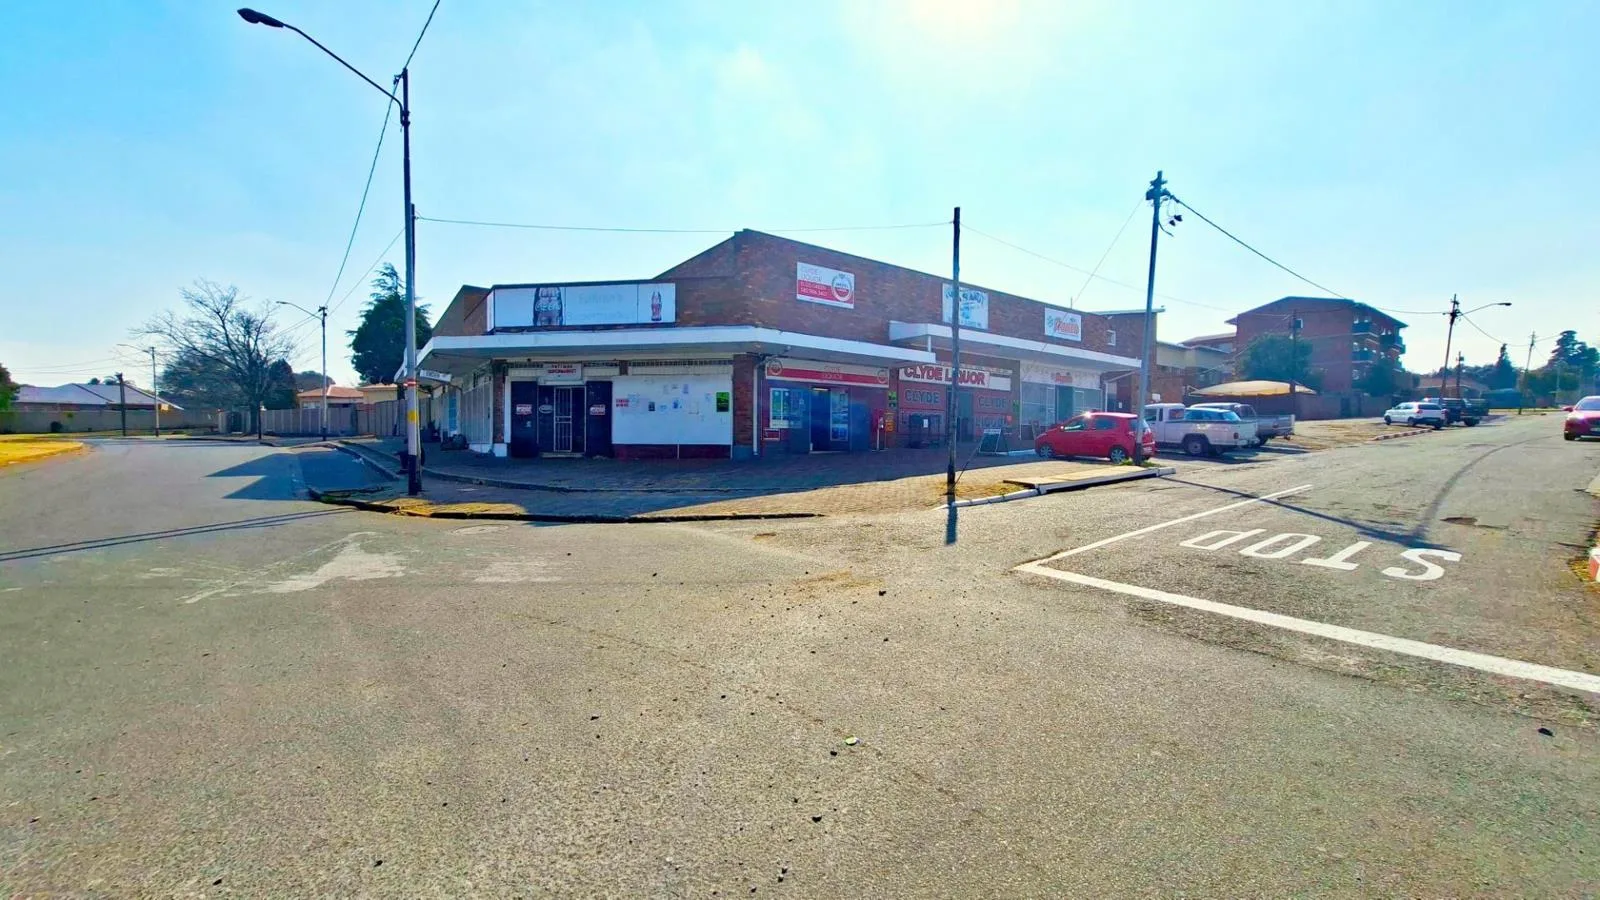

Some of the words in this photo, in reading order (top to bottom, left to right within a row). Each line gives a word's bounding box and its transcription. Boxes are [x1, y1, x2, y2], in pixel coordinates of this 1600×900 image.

[904, 364, 942, 380] CLYDE
[945, 367, 985, 386] LUOR
[904, 389, 941, 404] CLYDE
[1180, 529, 1461, 580] STOP
